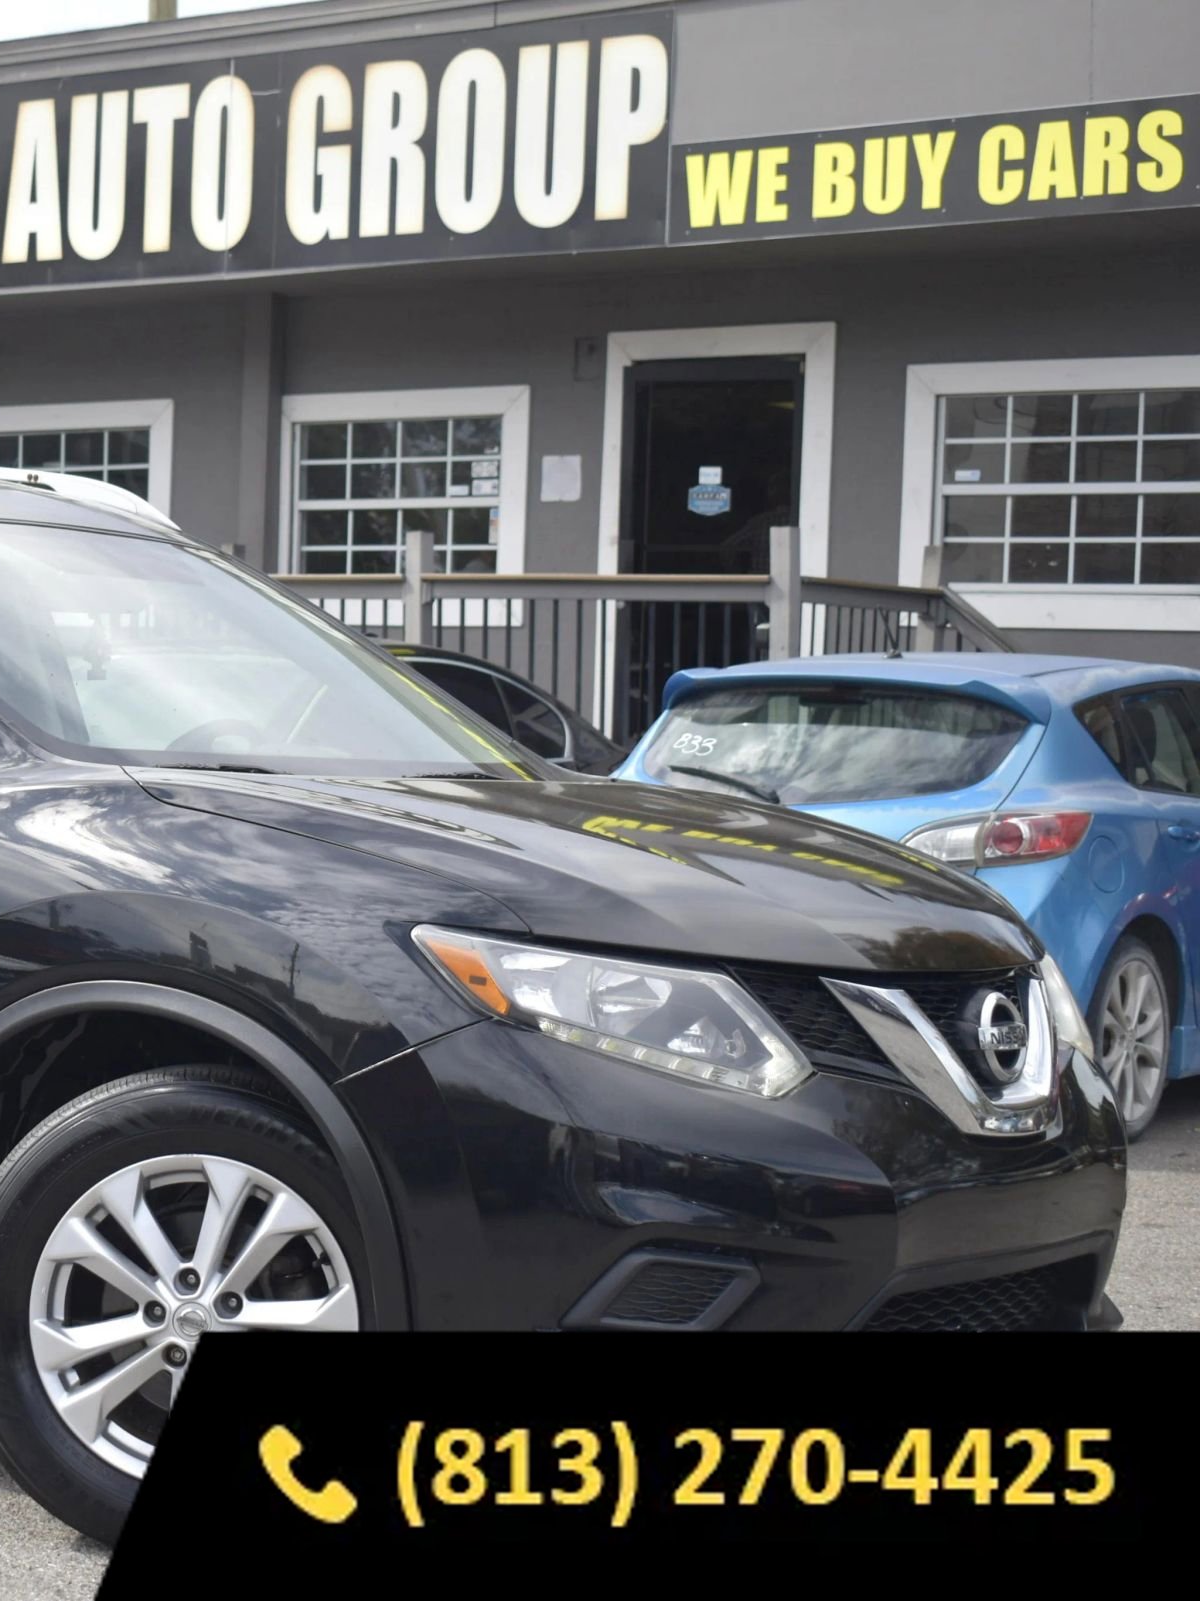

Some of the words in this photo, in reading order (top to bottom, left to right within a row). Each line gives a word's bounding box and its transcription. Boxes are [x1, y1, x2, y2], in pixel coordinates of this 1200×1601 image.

[1, 74, 256, 264] AUTO
[284, 33, 668, 245] GROUP
[685, 146, 790, 228] WE
[811, 130, 957, 219] BUY
[977, 109, 1184, 206] CARS
[672, 732, 717, 757] 833
